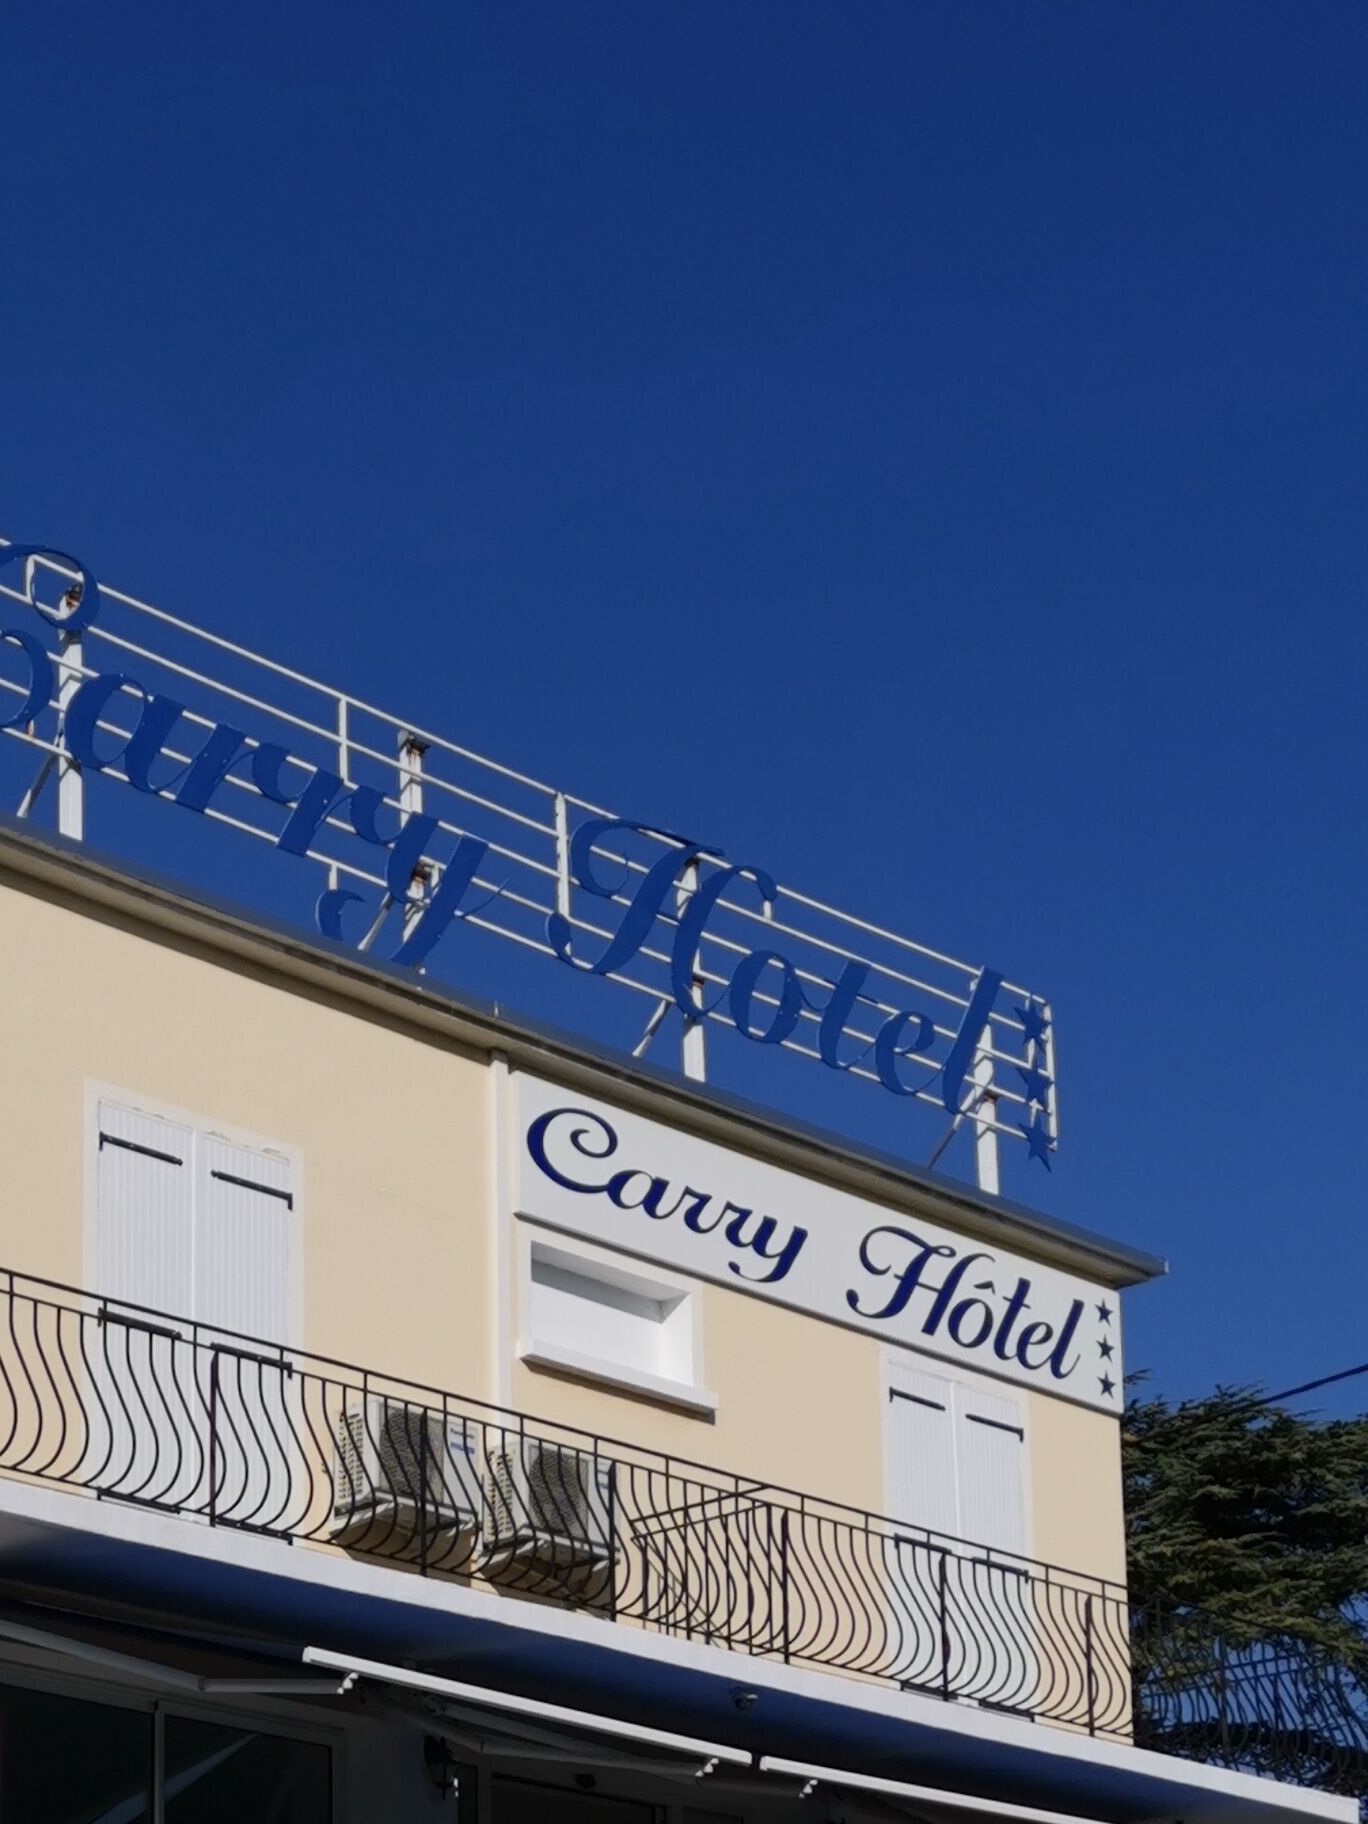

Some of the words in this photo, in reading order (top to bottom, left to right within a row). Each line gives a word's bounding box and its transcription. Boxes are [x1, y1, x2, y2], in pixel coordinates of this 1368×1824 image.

[545, 818, 1003, 1116] Hotel
[526, 1107, 808, 1283] Carry
[846, 1225, 1085, 1379] Hôtel
